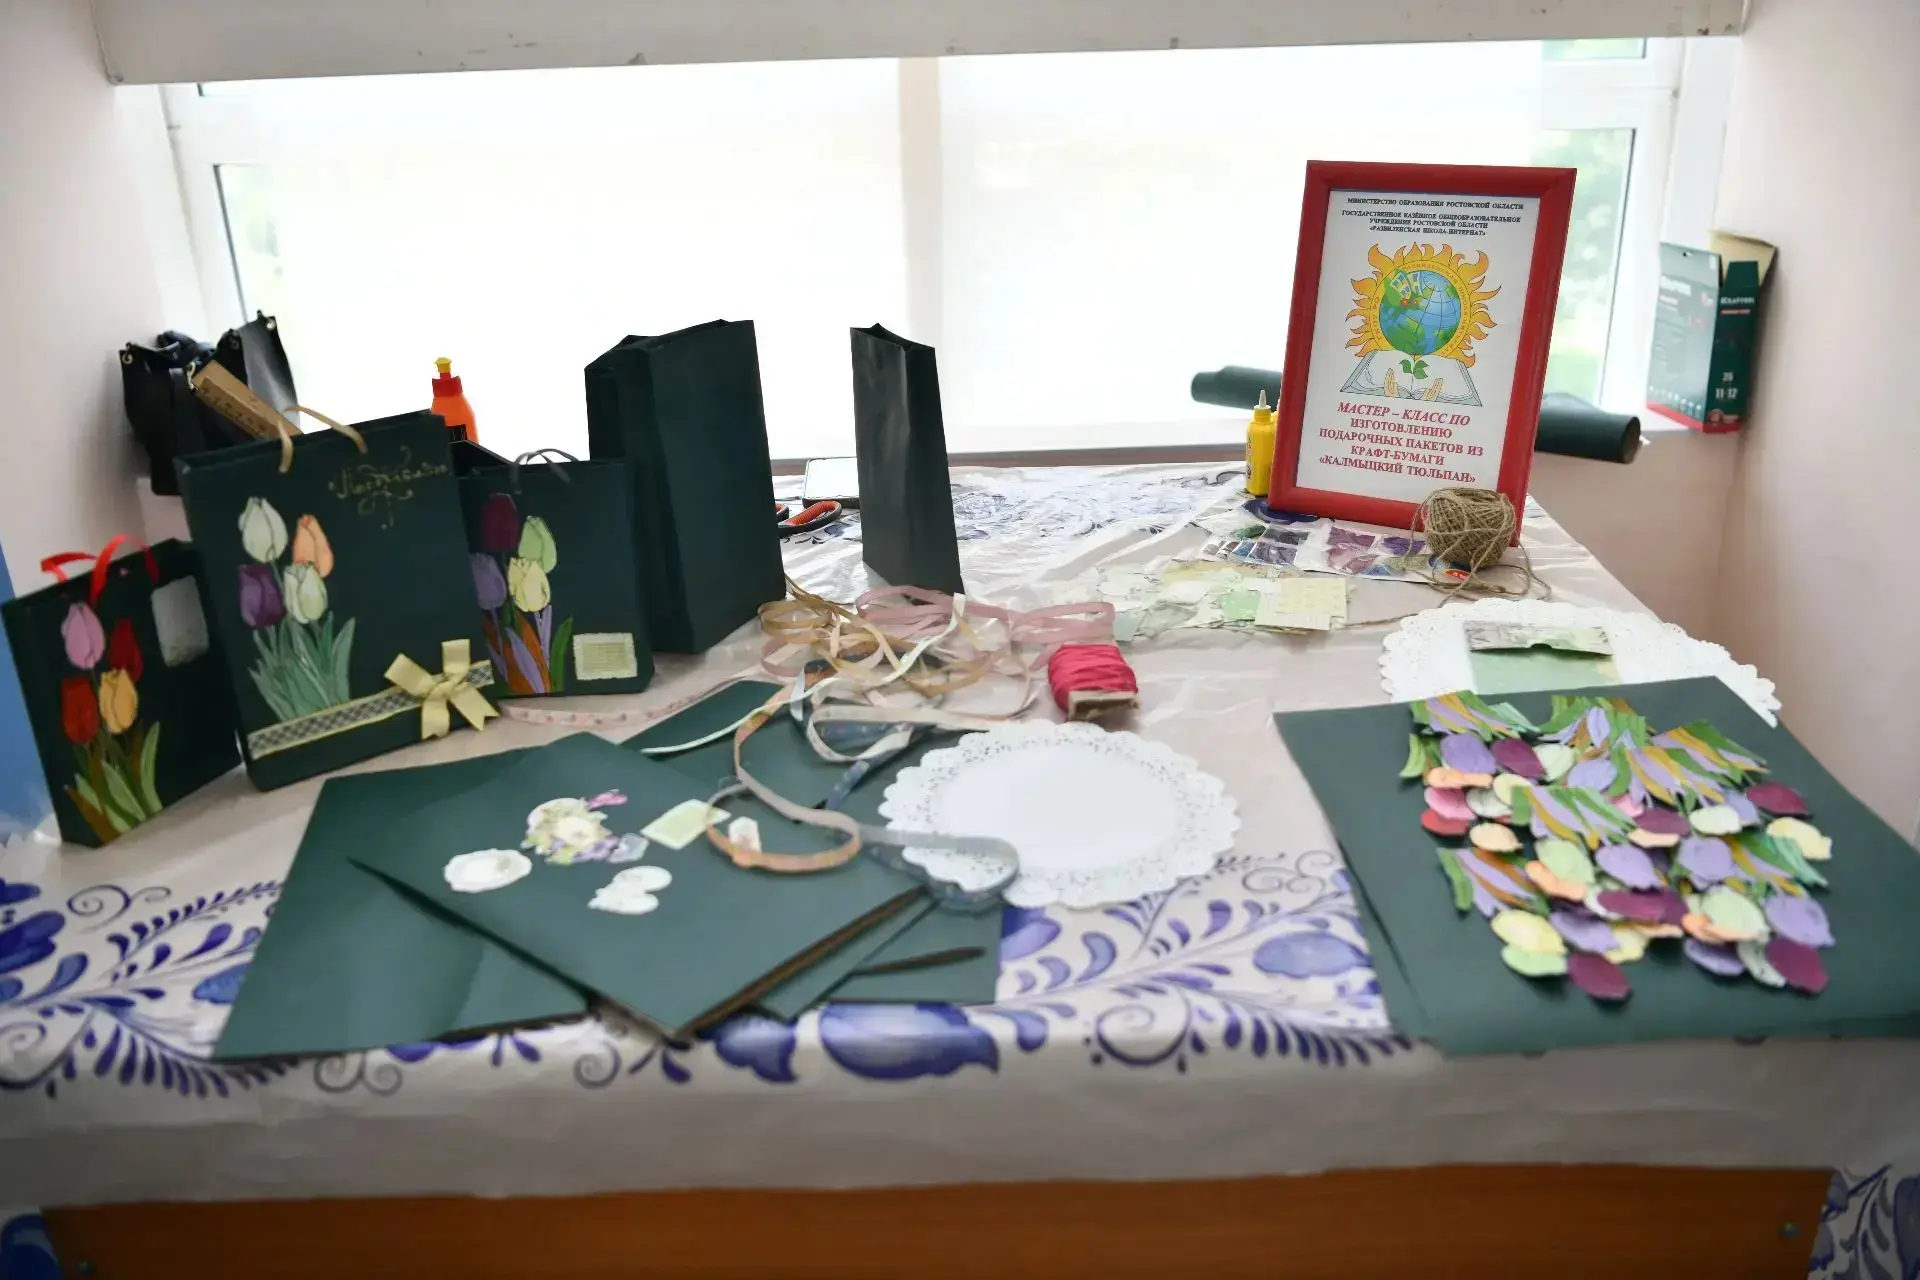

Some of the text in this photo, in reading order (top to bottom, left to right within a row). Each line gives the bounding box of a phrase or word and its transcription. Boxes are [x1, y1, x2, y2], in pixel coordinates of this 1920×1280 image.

[1337, 402, 1390, 416] МАСТЕР
[1402, 409, 1448, 423] КЛАСС
[1448, 415, 1470, 426] ПО
[1350, 418, 1452, 438] ИЗГОТОВЛЕНИЮ
[1319, 428, 1483, 456] ПОДАРОЧНЫХ ПАКЕТОВ ИЗ
[1350, 446, 1444, 465] КРАФТ-БУМАГИ
[1319, 455, 1476, 483] «КАЛМЫЦКИЙ ТЮЛЬПАН»
